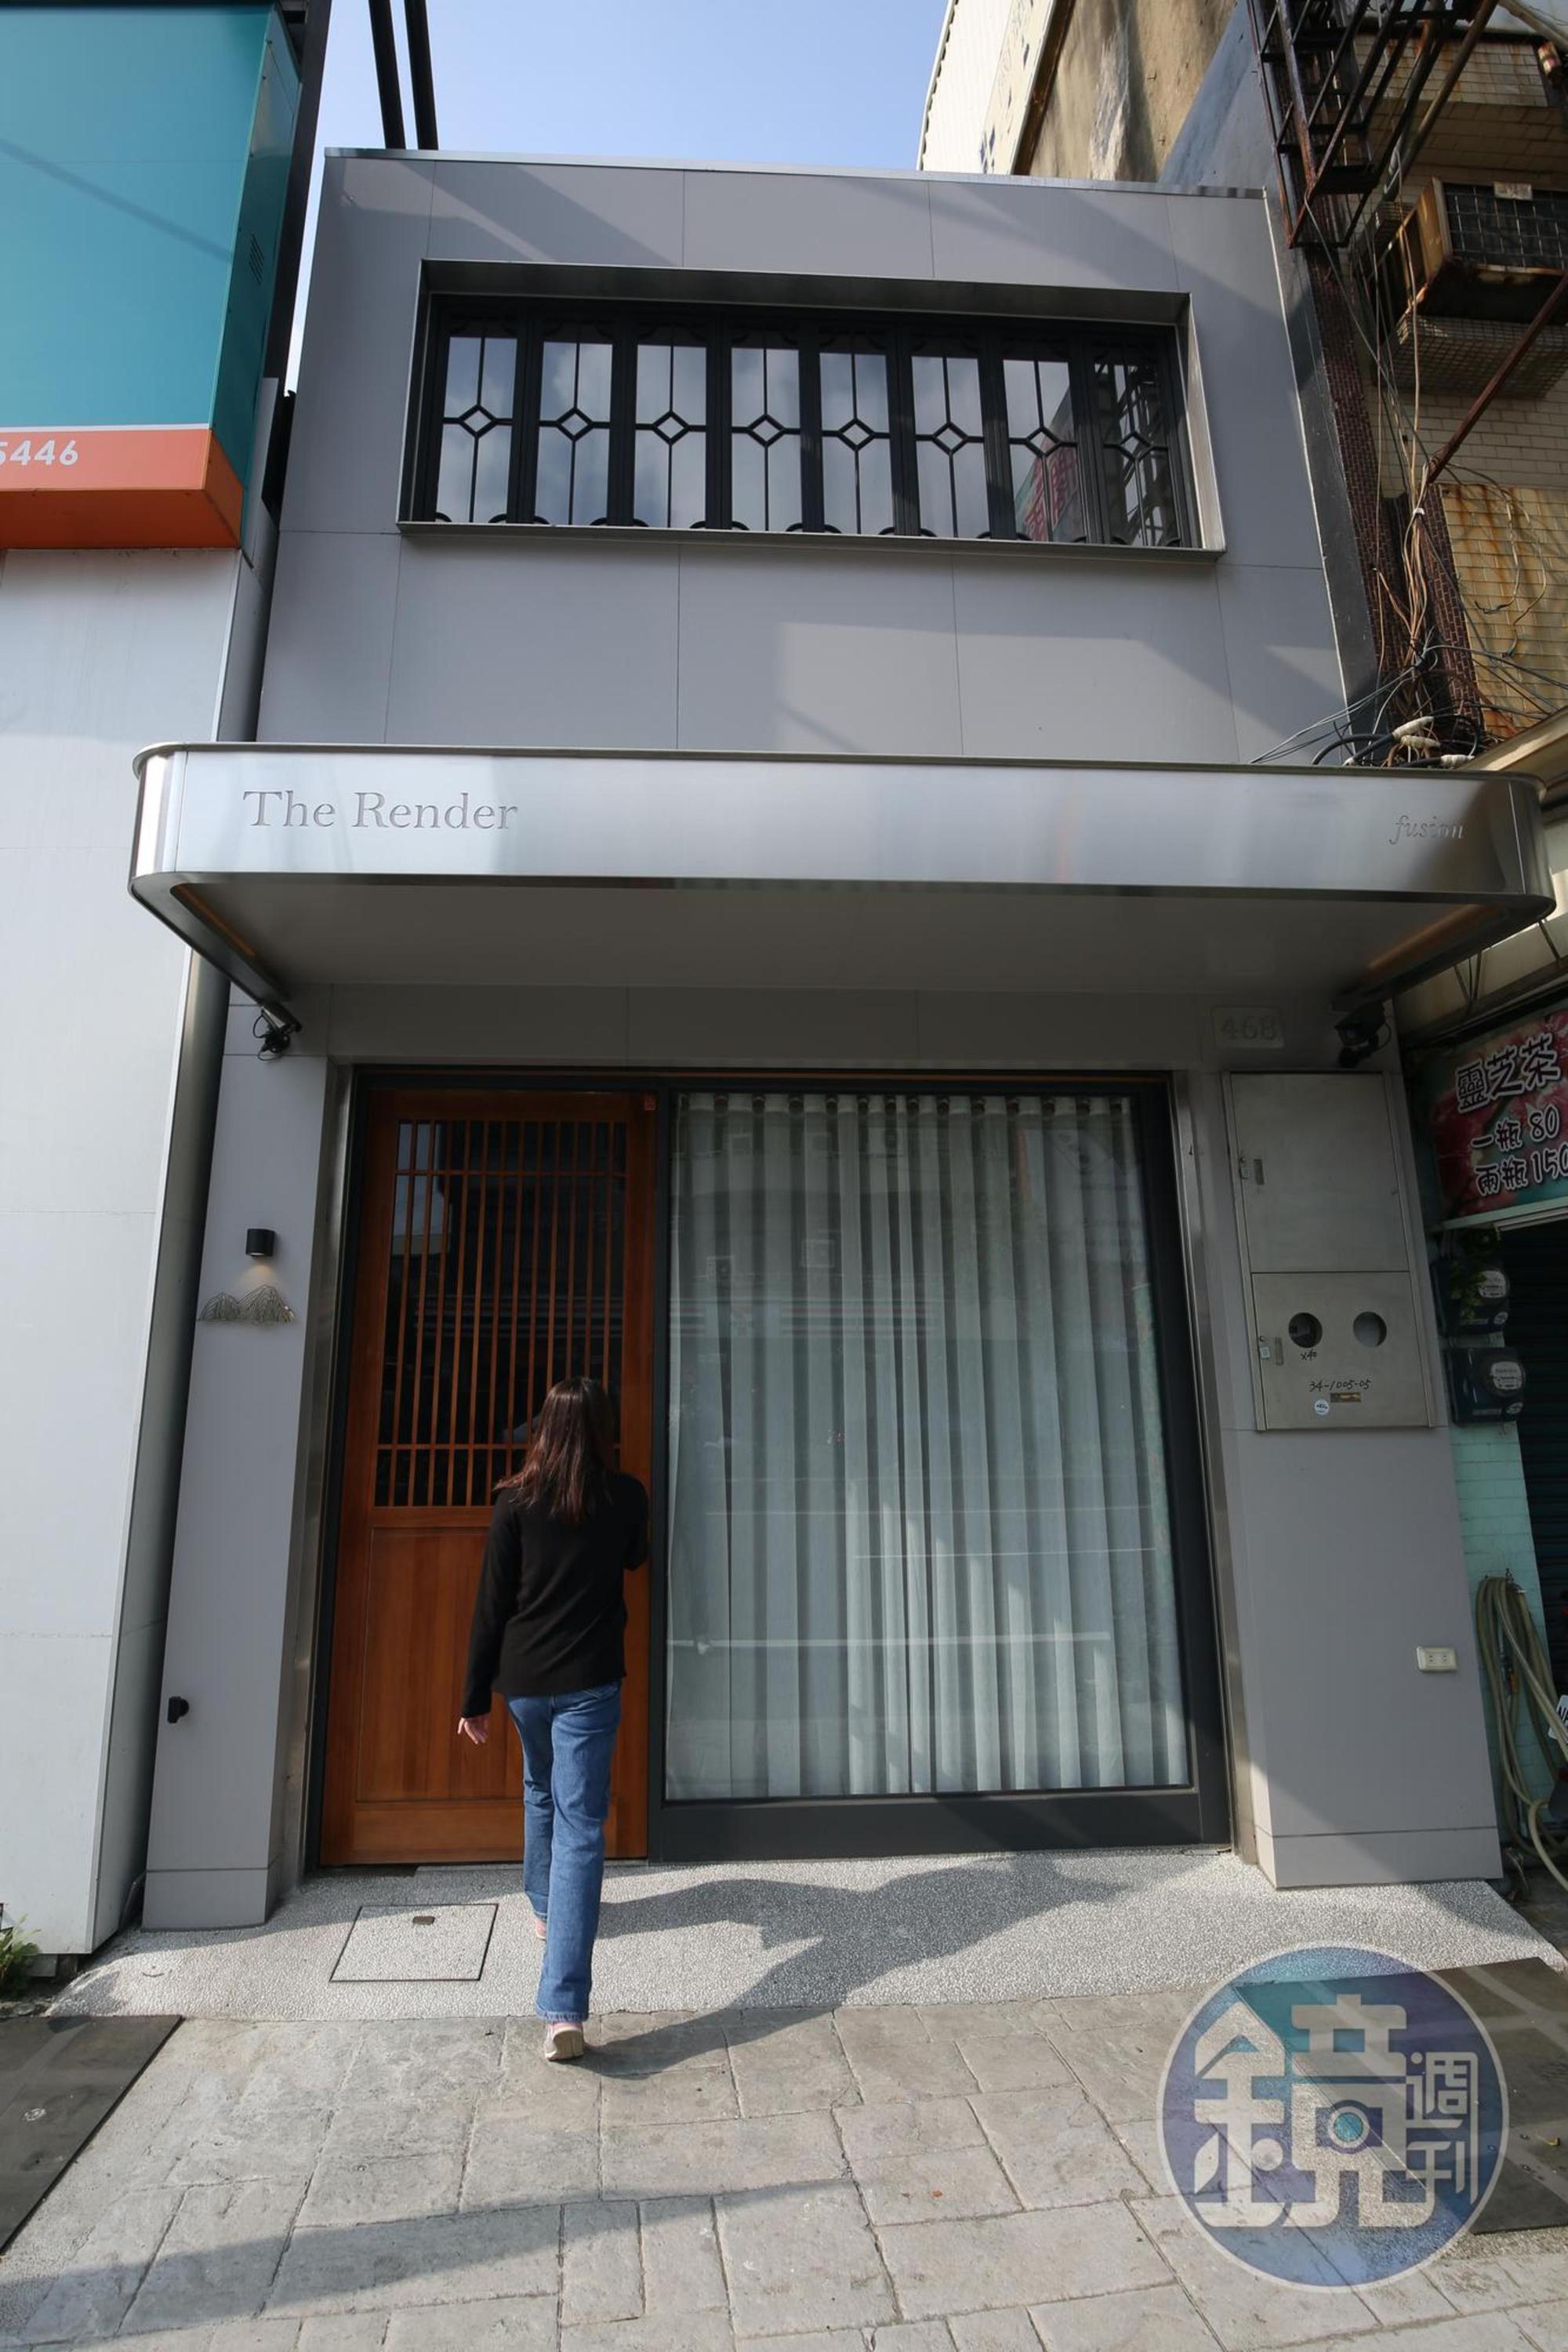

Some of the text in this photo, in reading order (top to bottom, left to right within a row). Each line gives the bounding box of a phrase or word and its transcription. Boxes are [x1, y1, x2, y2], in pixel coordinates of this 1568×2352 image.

[243, 790, 518, 829] The Render
[1388, 815, 1464, 845] fusion
[1456, 1035, 1560, 1111] 靈芝茶
[1471, 1105, 1559, 1152] 一瓶 80
